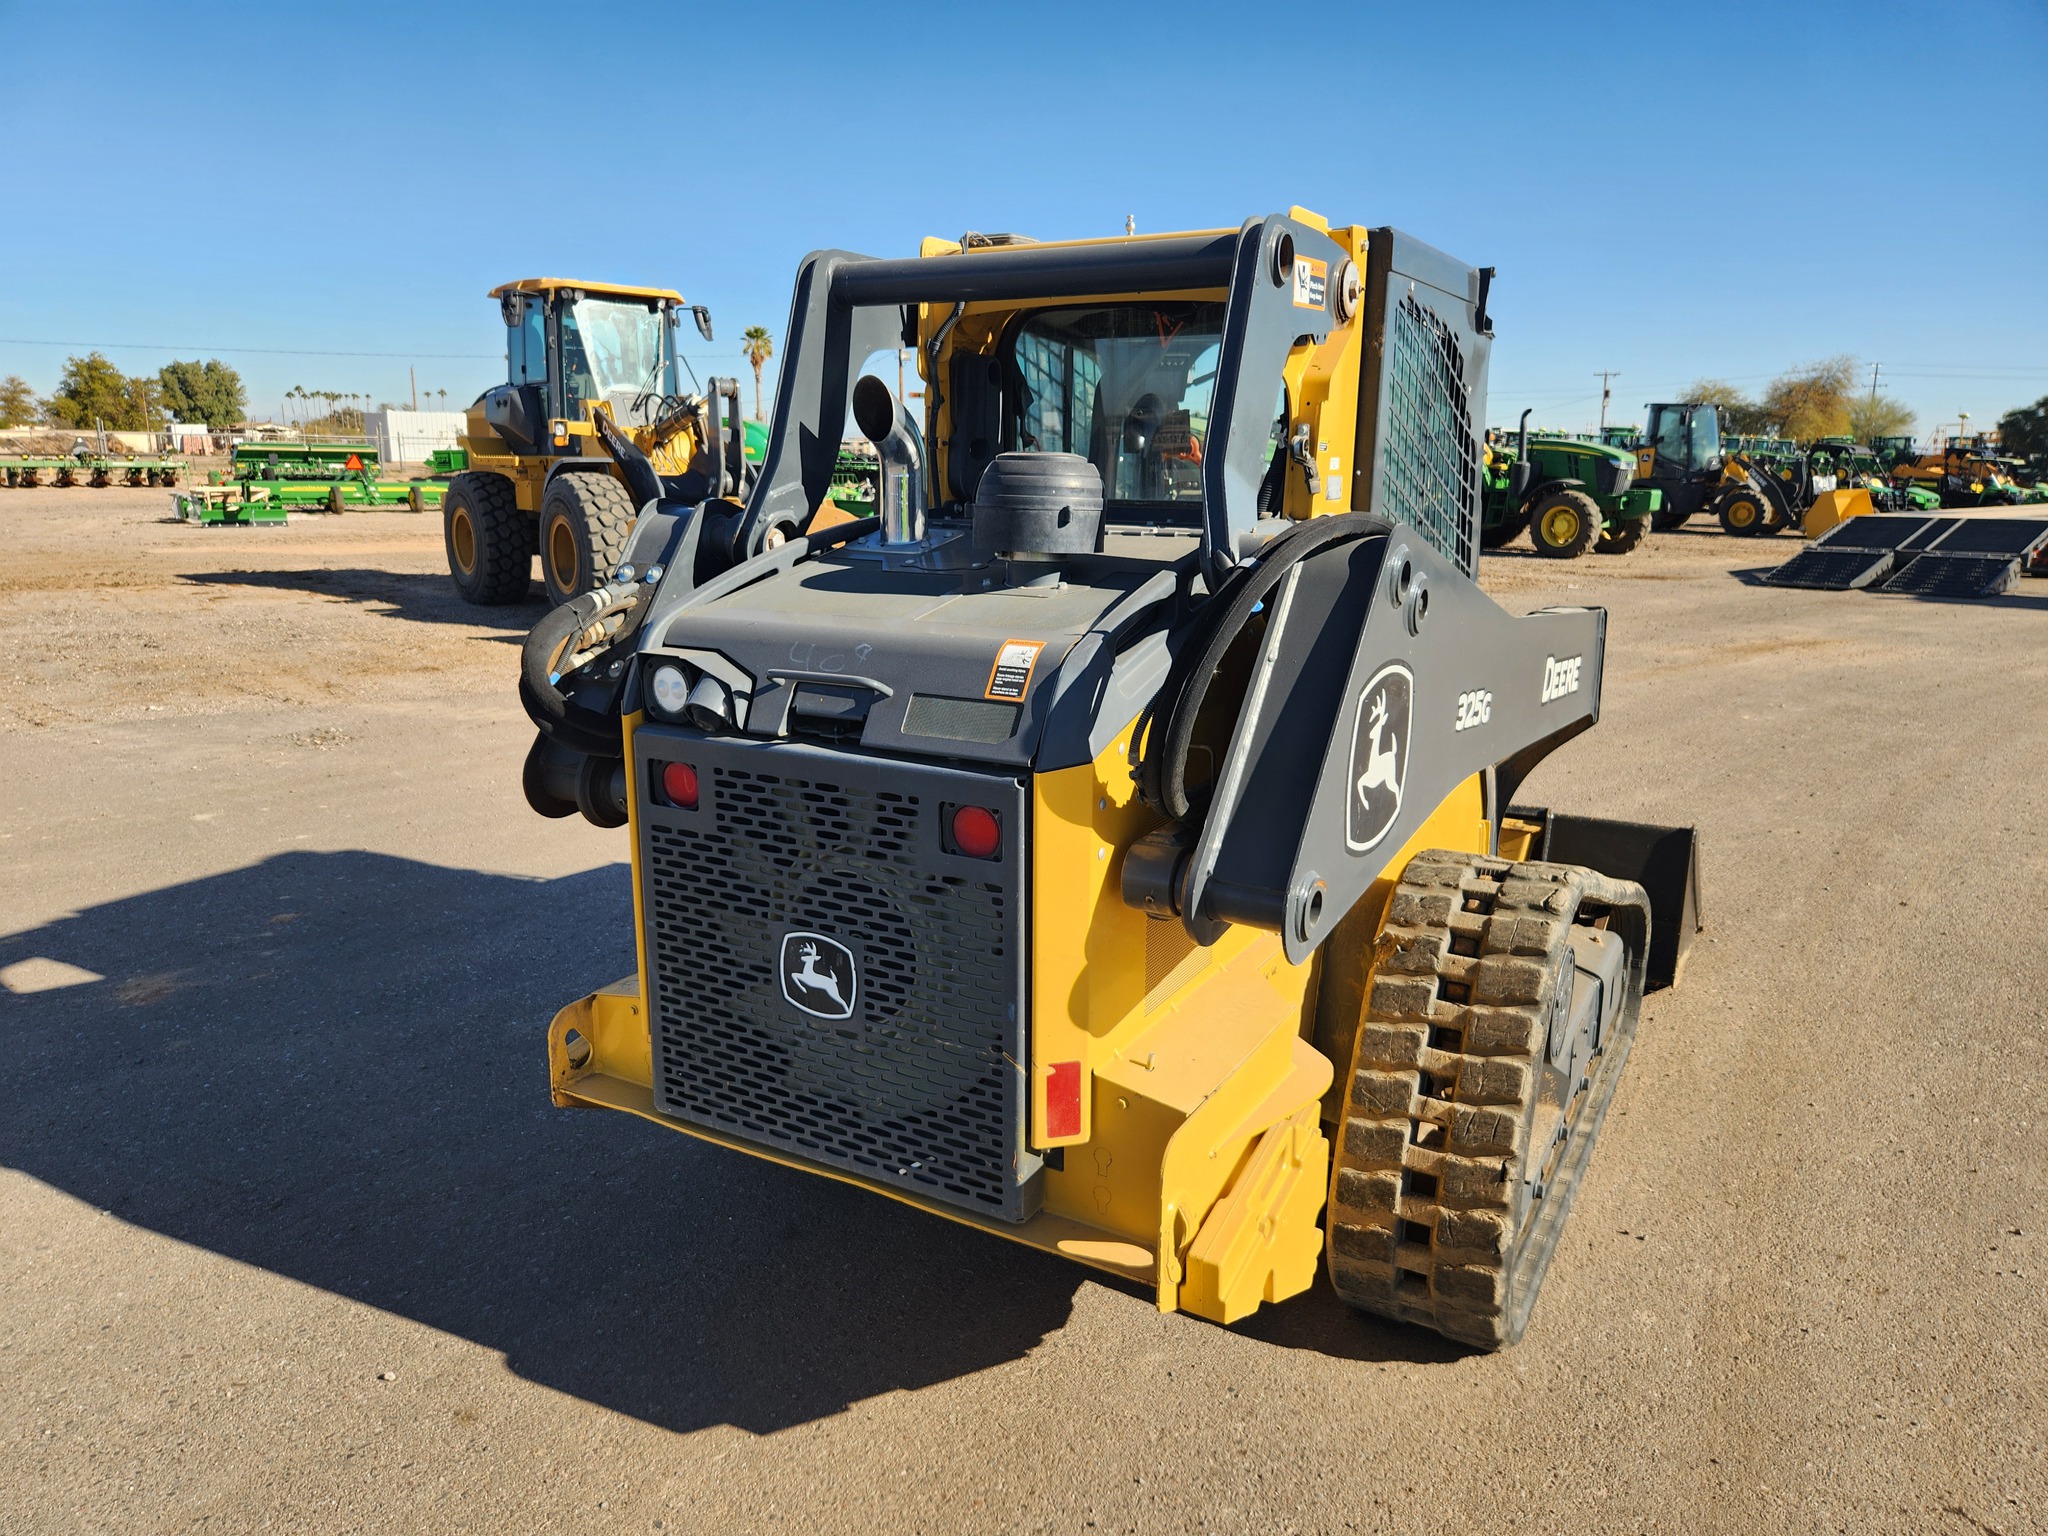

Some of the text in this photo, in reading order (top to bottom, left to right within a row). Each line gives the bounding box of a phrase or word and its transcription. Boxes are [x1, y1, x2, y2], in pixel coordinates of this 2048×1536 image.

[602, 420, 626, 459] DEERE
[1541, 655, 1582, 704] DEERE
[1455, 689, 1493, 731] 325G
